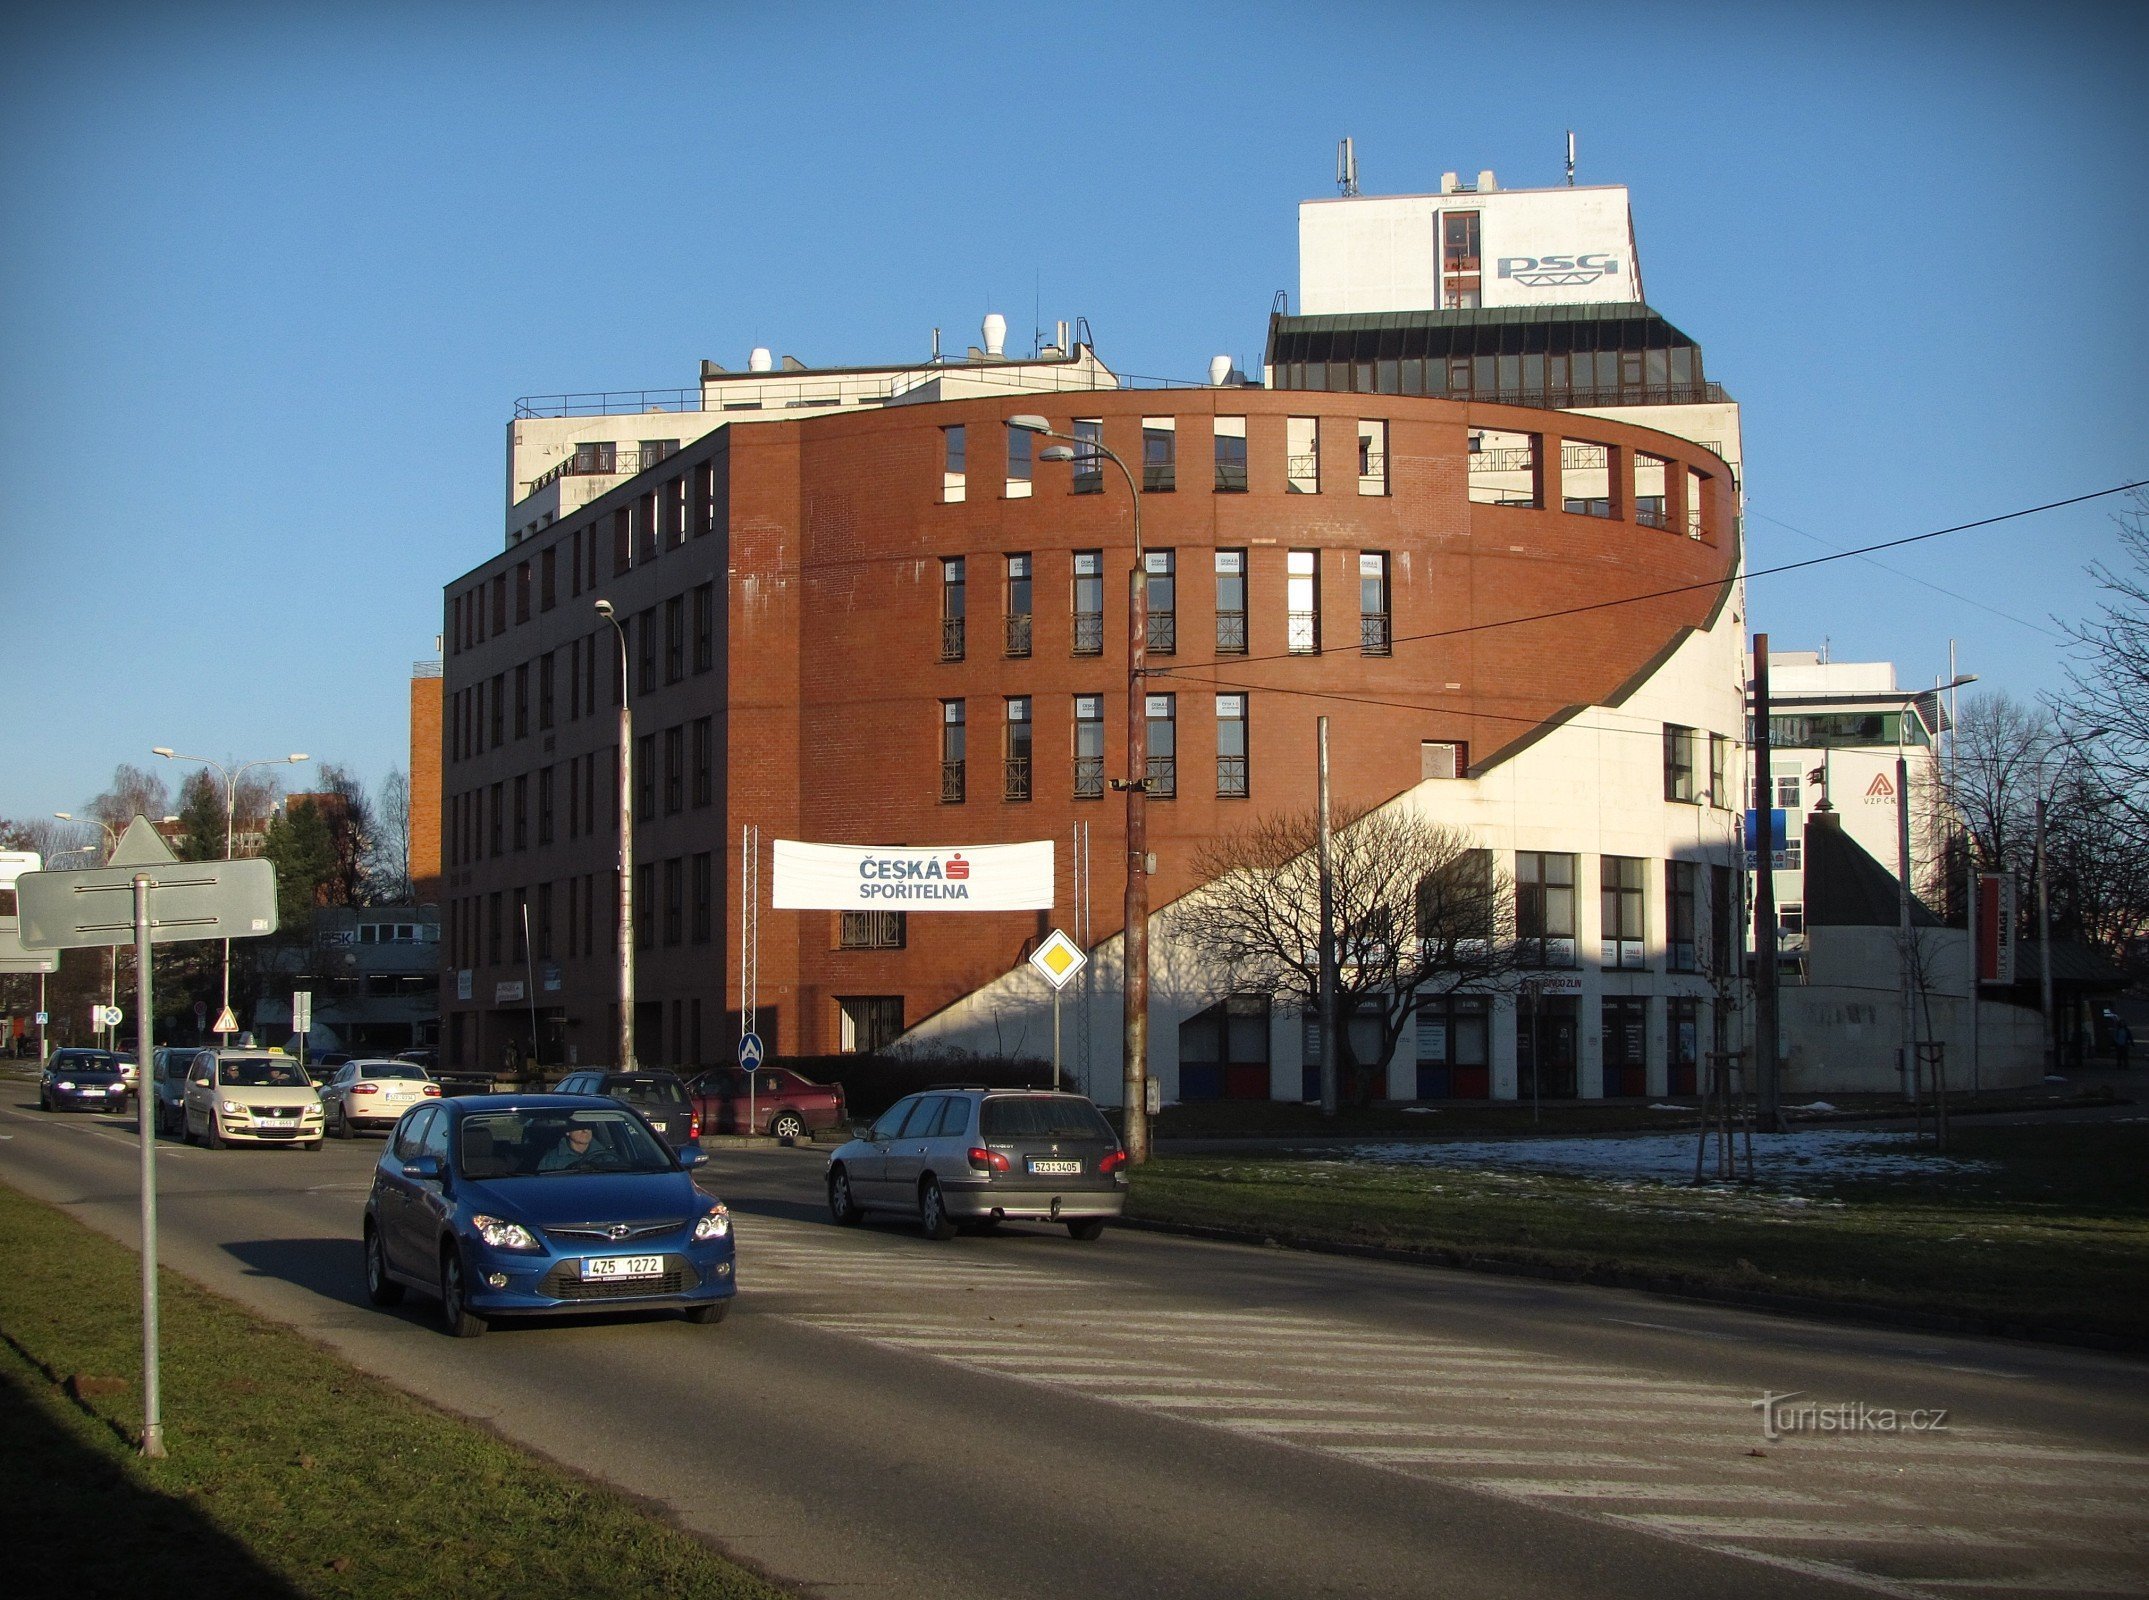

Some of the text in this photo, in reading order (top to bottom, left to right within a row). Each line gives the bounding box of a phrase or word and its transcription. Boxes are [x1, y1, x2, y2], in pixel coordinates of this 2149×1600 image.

[1498, 253, 1618, 278] PSG
[1864, 796, 1896, 805] VZP ČR
[860, 855, 943, 879] ČESKÁ
[860, 881, 969, 899] SPOŘITELNA
[1999, 910, 2008, 946] IMAGE
[1035, 1163, 1077, 1172] 5Z3 3405
[592, 1258, 657, 1275] 4Z5 1272
